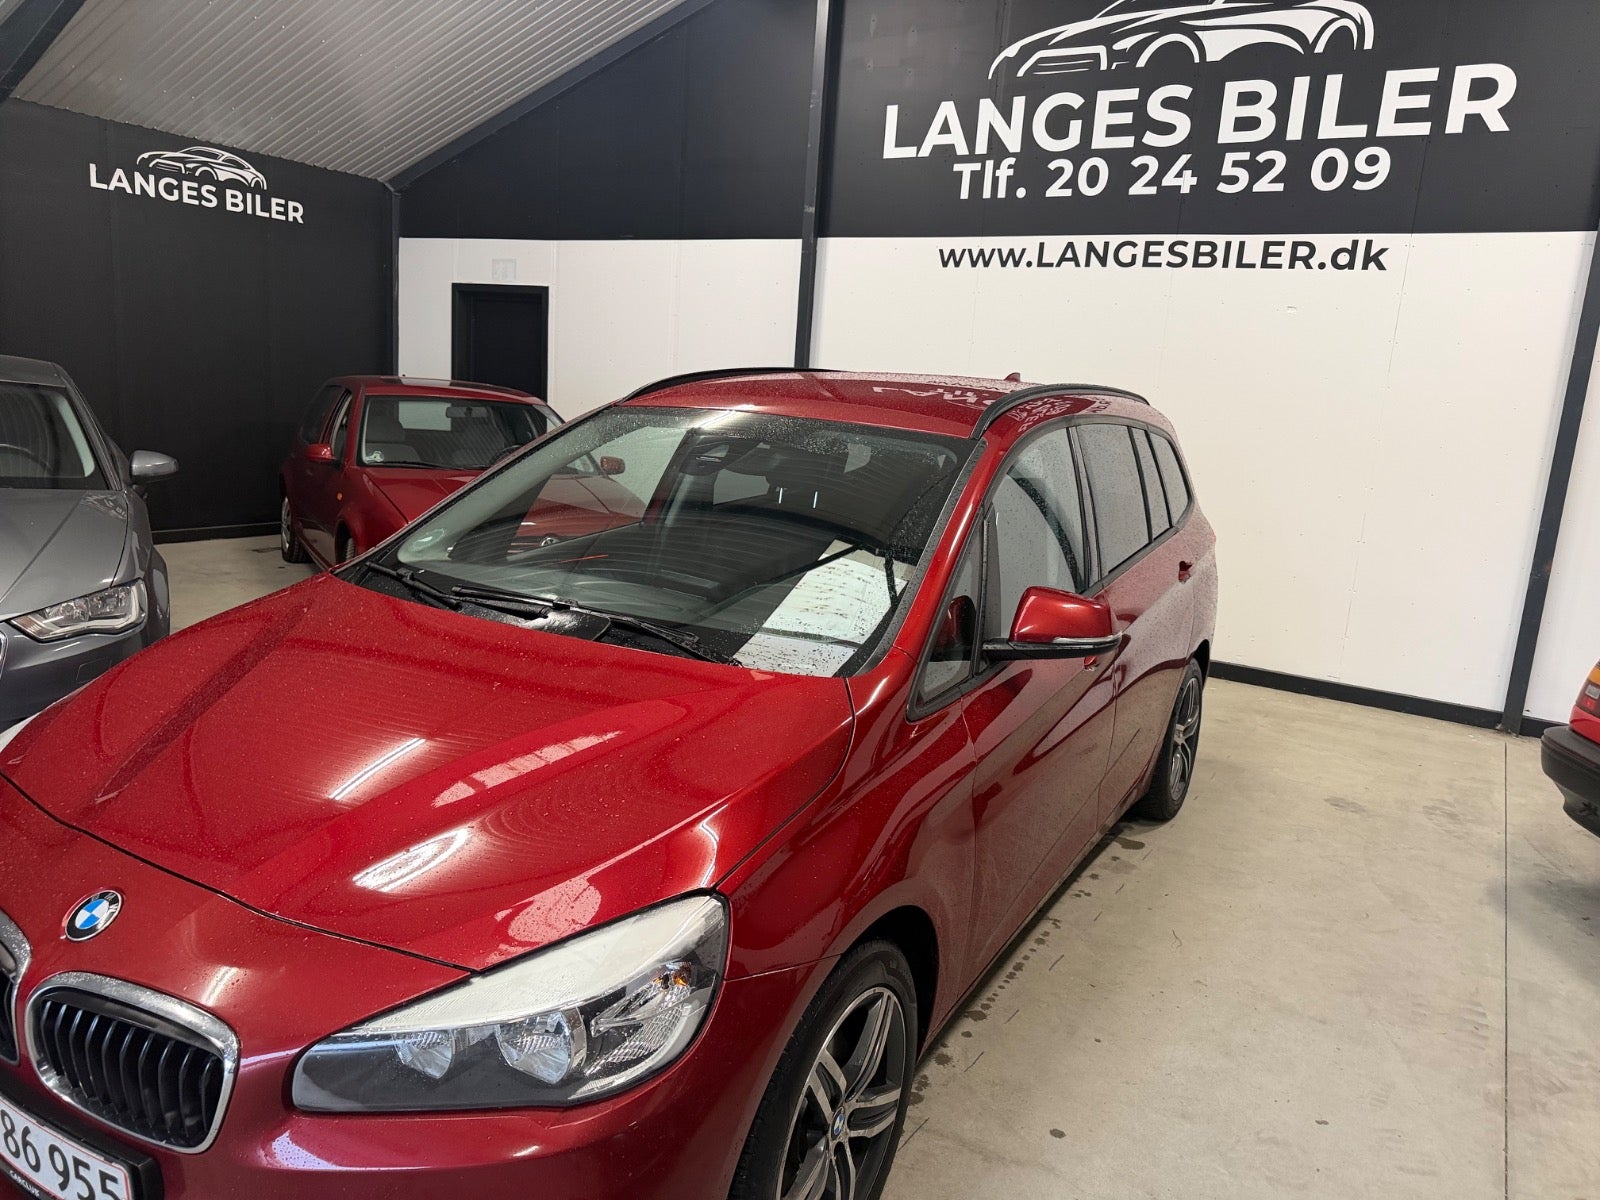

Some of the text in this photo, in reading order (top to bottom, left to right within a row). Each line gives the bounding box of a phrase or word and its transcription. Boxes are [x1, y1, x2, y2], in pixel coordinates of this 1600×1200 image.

[882, 62, 1518, 160] LANGES BILER
[89, 163, 304, 224] LANGES BILER
[952, 146, 1391, 200] Tlf. 20 24 52 09
[938, 239, 1389, 271] www.LANGESBILER.dk
[1, 1109, 121, 1200] 86 955
